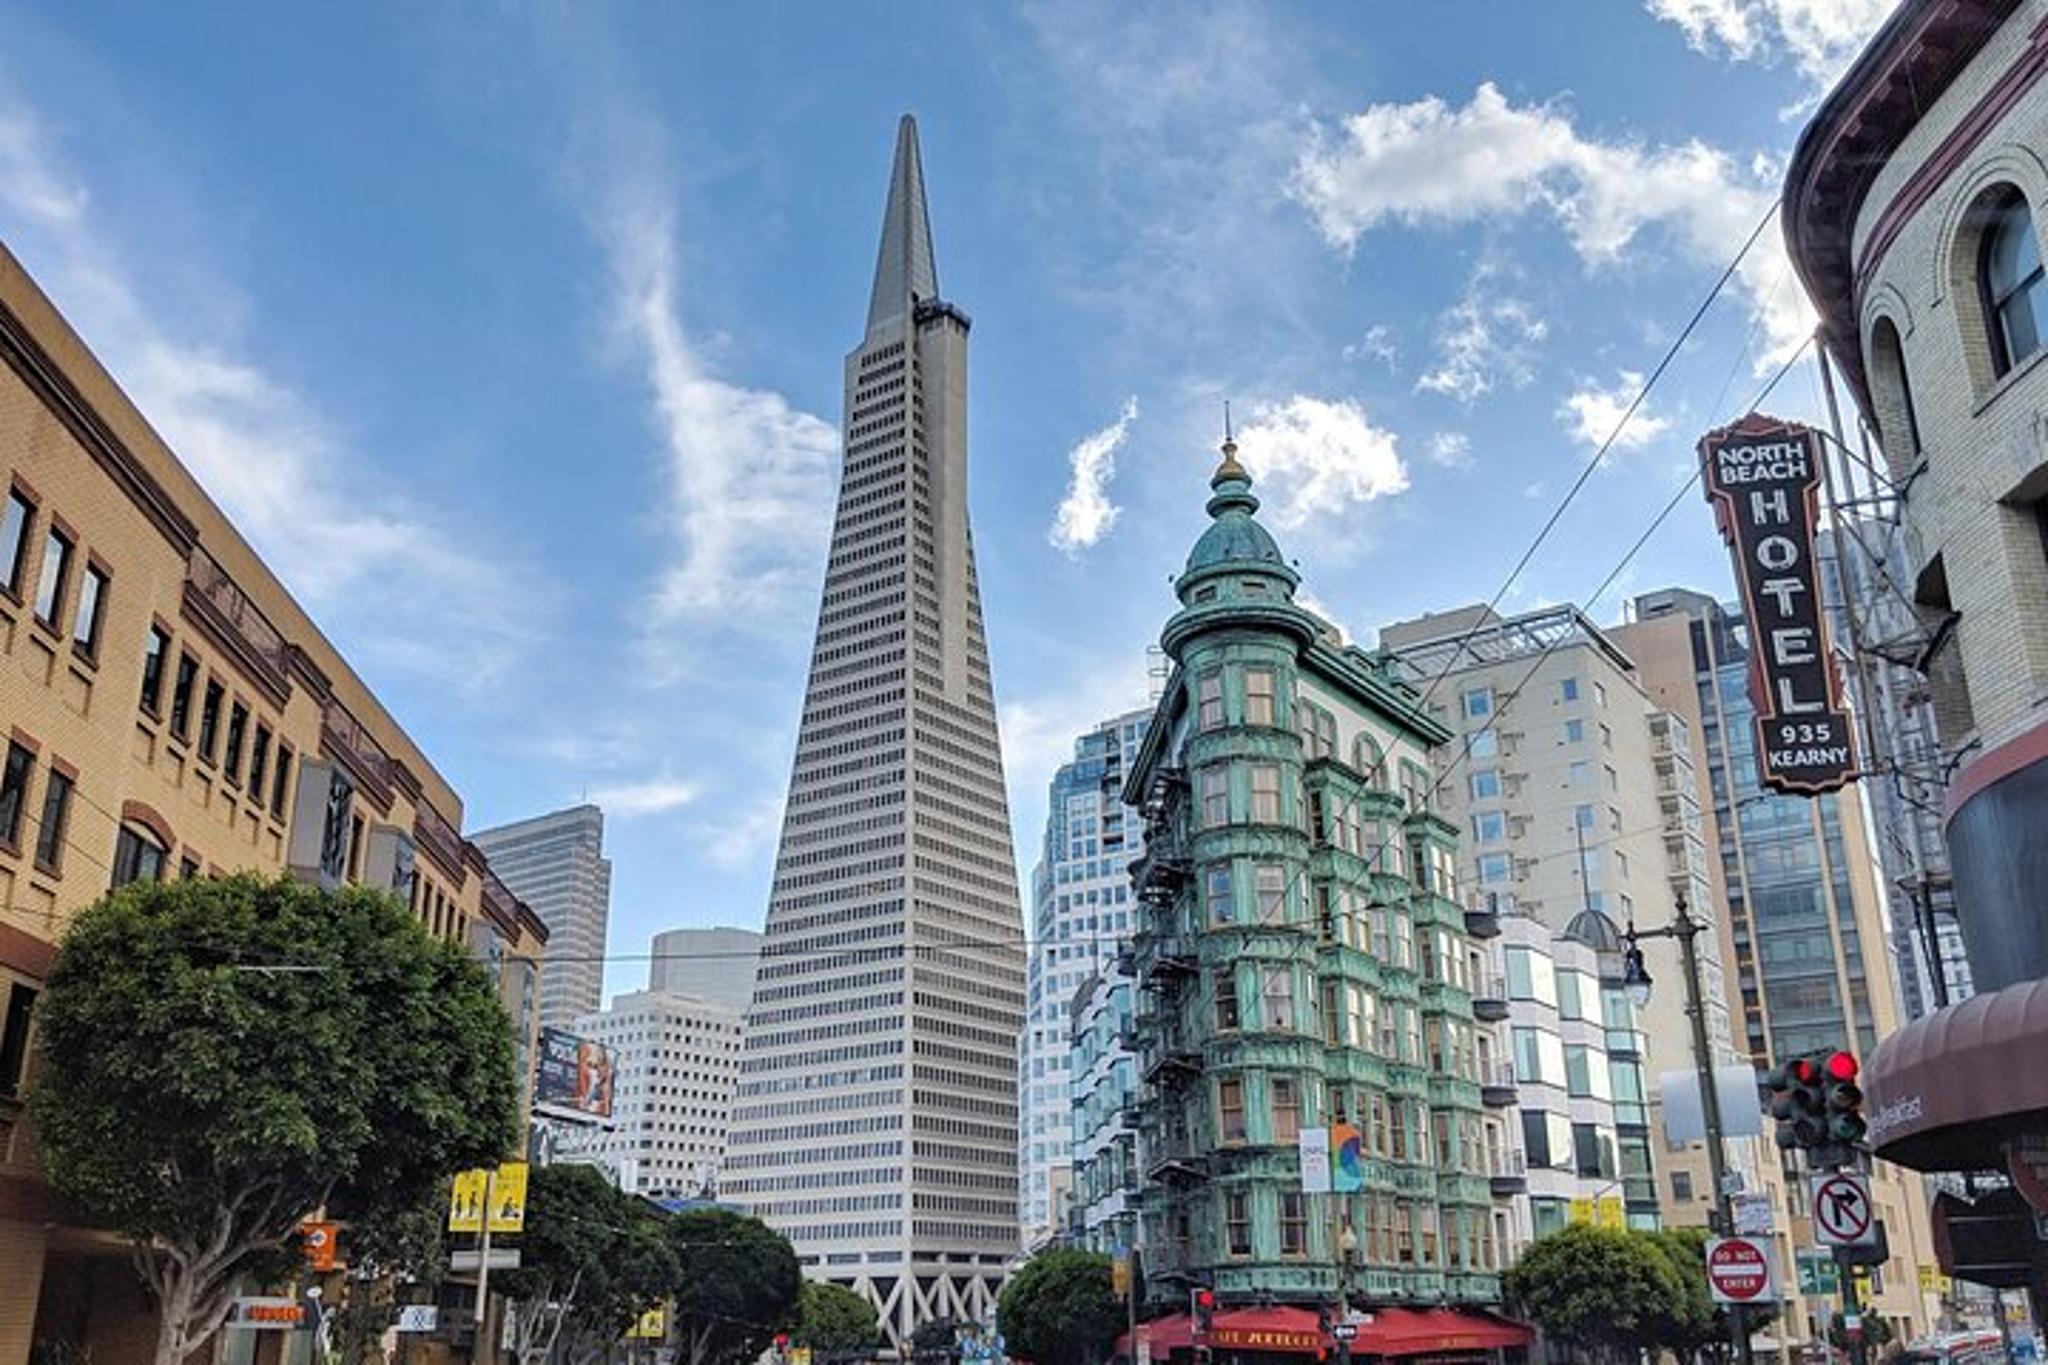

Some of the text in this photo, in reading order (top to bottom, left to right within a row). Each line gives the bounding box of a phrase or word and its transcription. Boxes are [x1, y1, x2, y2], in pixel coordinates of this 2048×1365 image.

[1718, 442, 1804, 465] NORTH
[1720, 461, 1807, 484] BEACH
[1750, 489, 1824, 713] HOTEL
[1781, 723, 1830, 743] 935
[1769, 747, 1847, 768] KEARNY
[1714, 1250, 1758, 1262] DO NOT
[1722, 1278, 1757, 1290] ENTER
